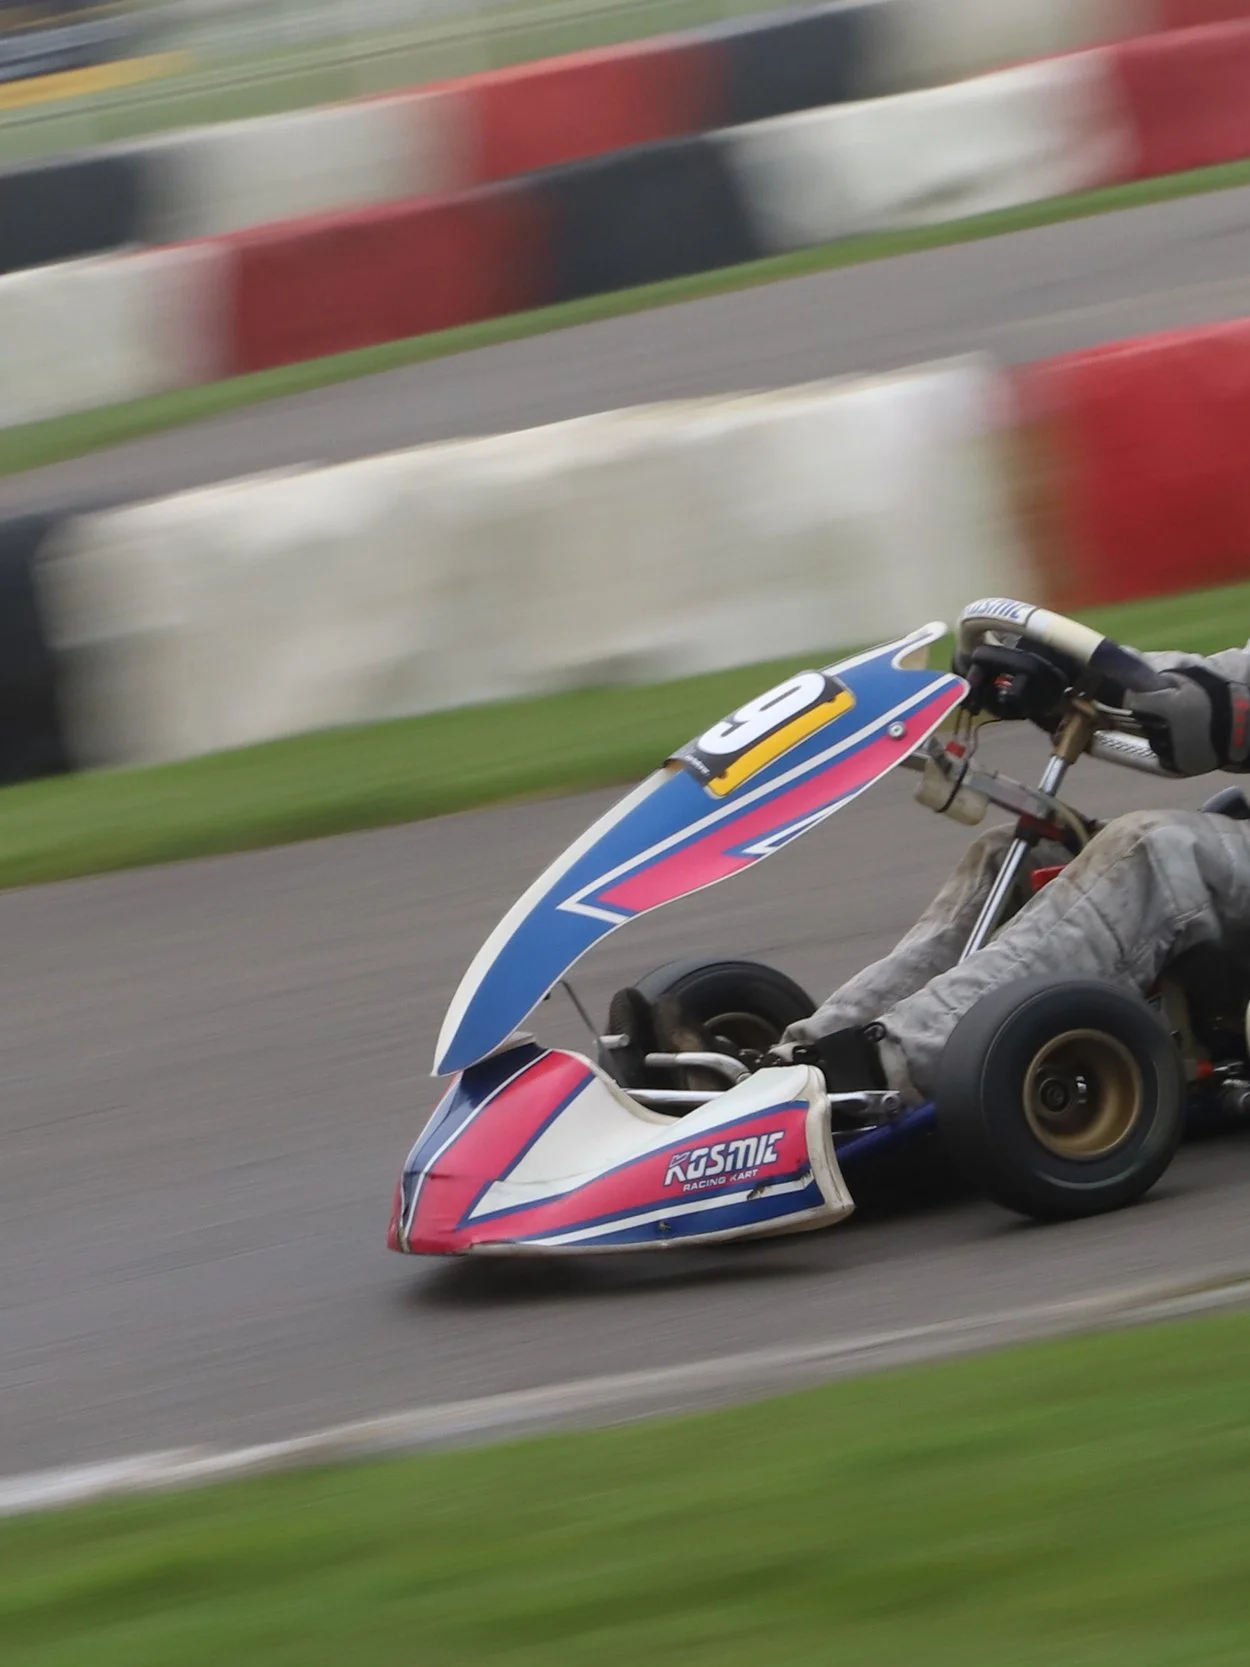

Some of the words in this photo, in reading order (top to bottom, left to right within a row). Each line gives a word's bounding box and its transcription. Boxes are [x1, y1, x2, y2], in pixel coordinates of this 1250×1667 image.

[697, 672, 826, 755] 9
[664, 1131, 785, 1186] KOSMIC
[683, 1175, 727, 1192] RACING
[730, 1168, 759, 1182] KART
